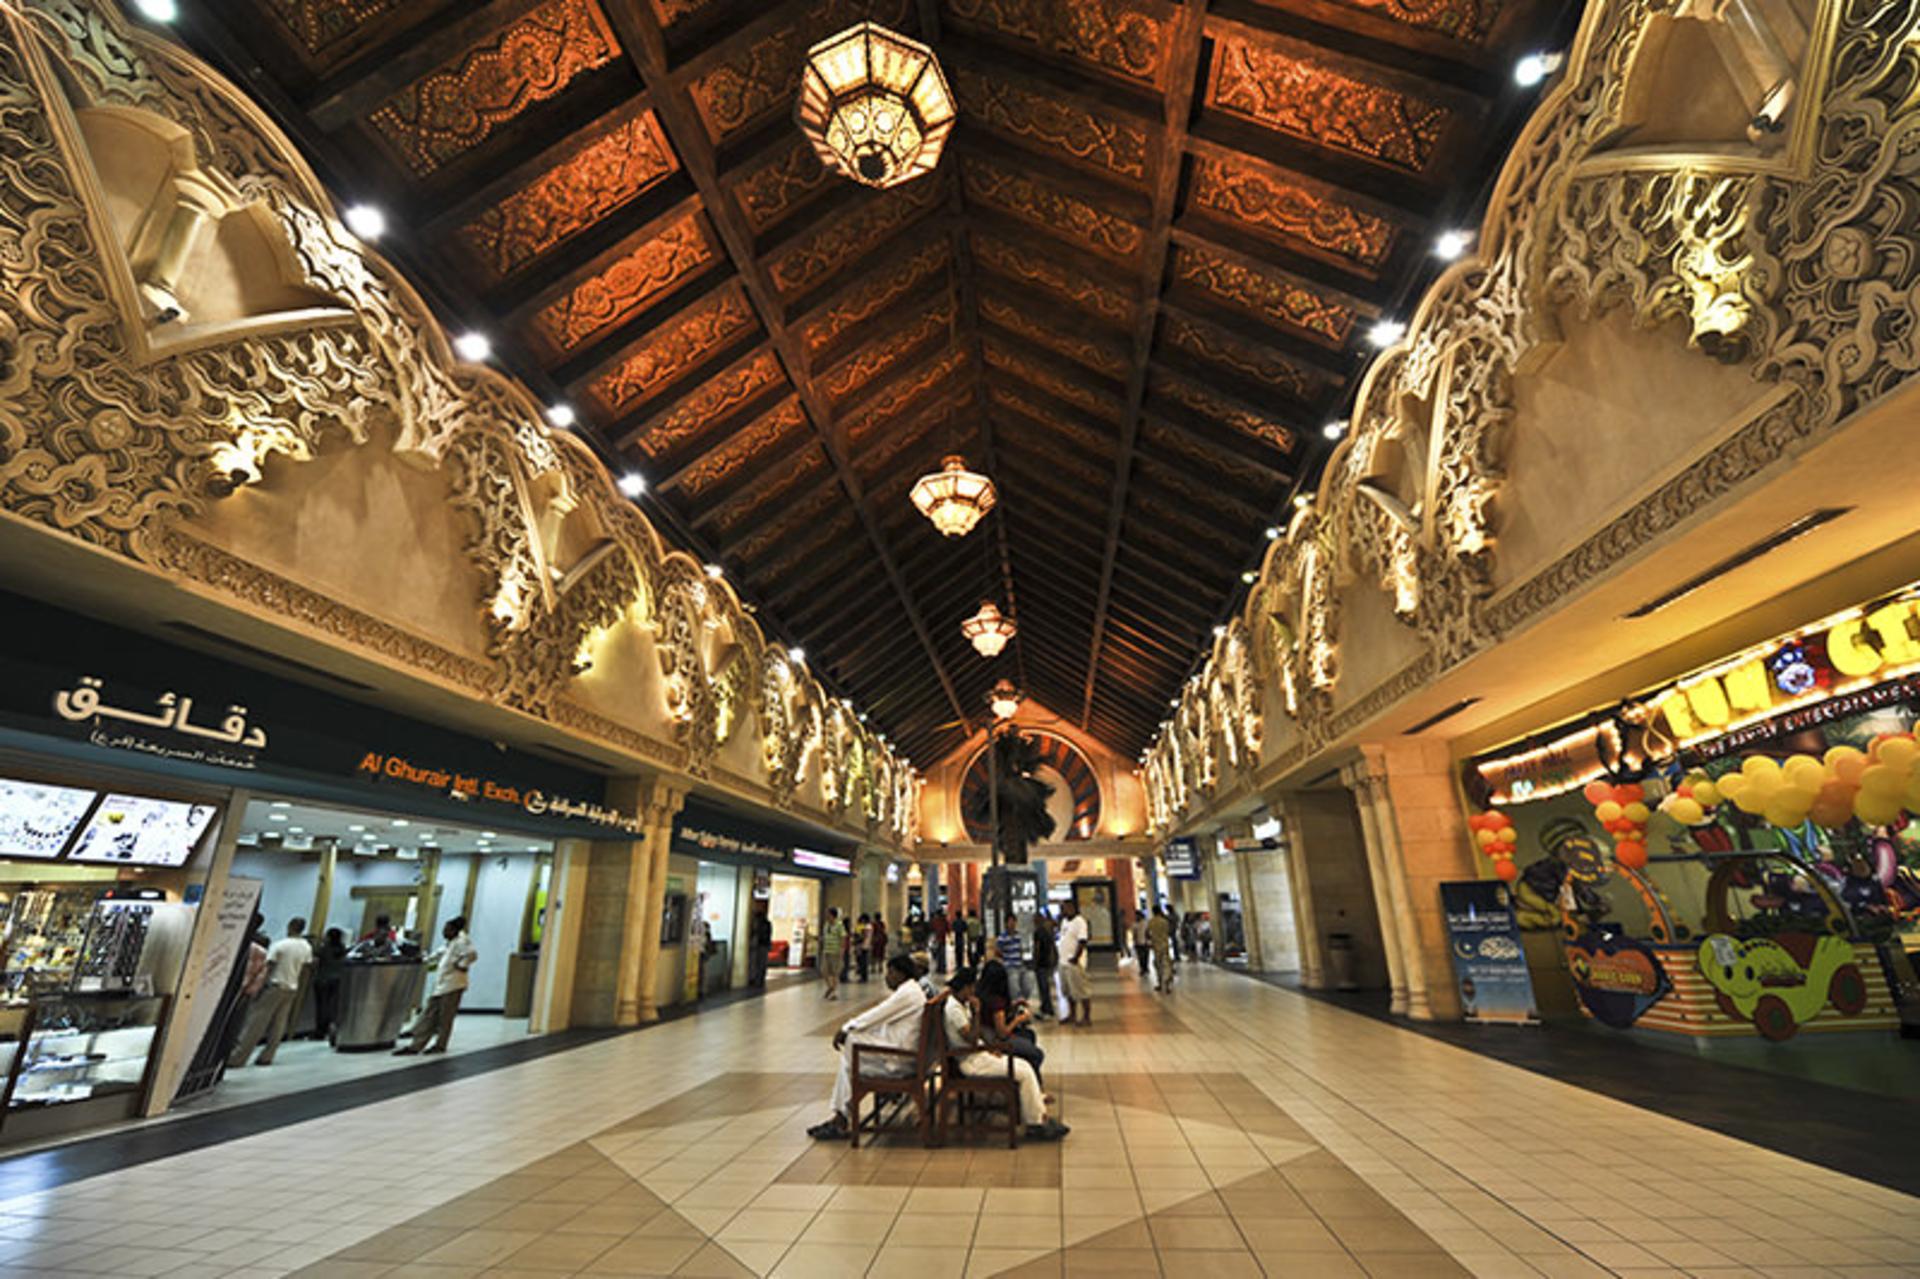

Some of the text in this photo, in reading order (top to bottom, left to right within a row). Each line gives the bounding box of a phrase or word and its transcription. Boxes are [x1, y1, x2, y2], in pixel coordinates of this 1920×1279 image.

[1661, 599, 1920, 739] FUN CI
[1784, 680, 1920, 732] ENTERTAINMEN
[359, 752, 383, 774] Al
[384, 757, 451, 788] Ghurair
